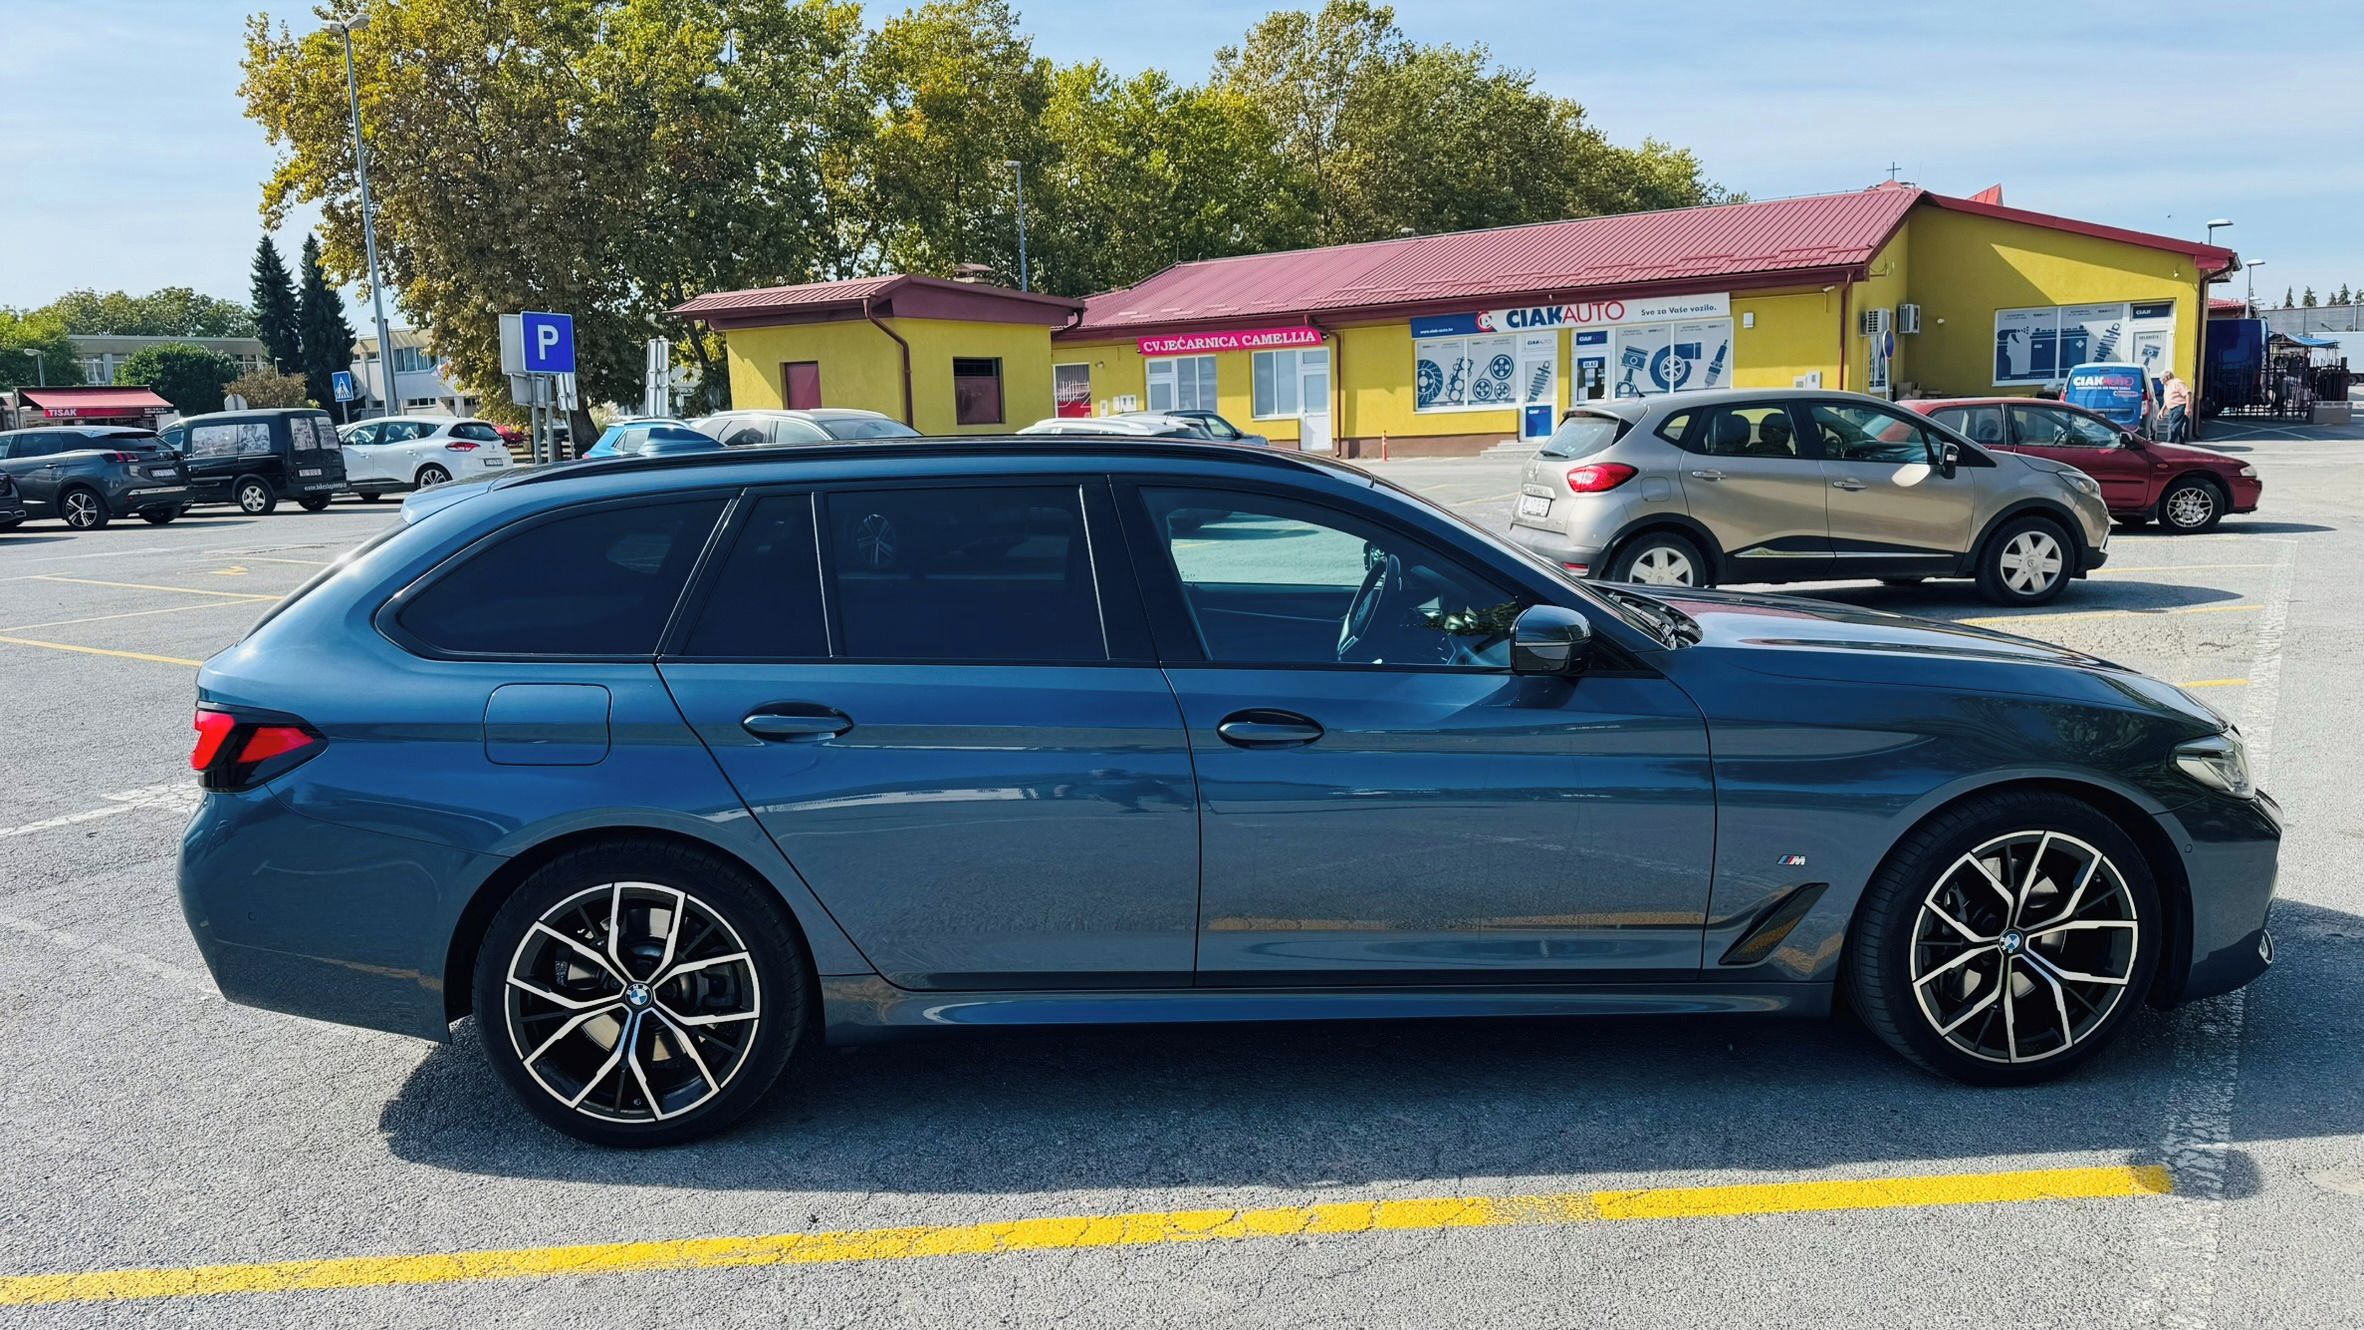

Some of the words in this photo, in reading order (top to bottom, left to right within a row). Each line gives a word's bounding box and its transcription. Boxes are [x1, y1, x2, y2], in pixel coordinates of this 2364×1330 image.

[1641, 308, 1655, 316] Sve
[1668, 305, 1688, 314] Vaše
[1689, 303, 1718, 313] vozilo.
[538, 325, 558, 360] P
[1143, 336, 1239, 352] CVJEĆARNICA
[1241, 330, 1316, 346] CAMELLIA
[48, 408, 77, 417] TISAK
